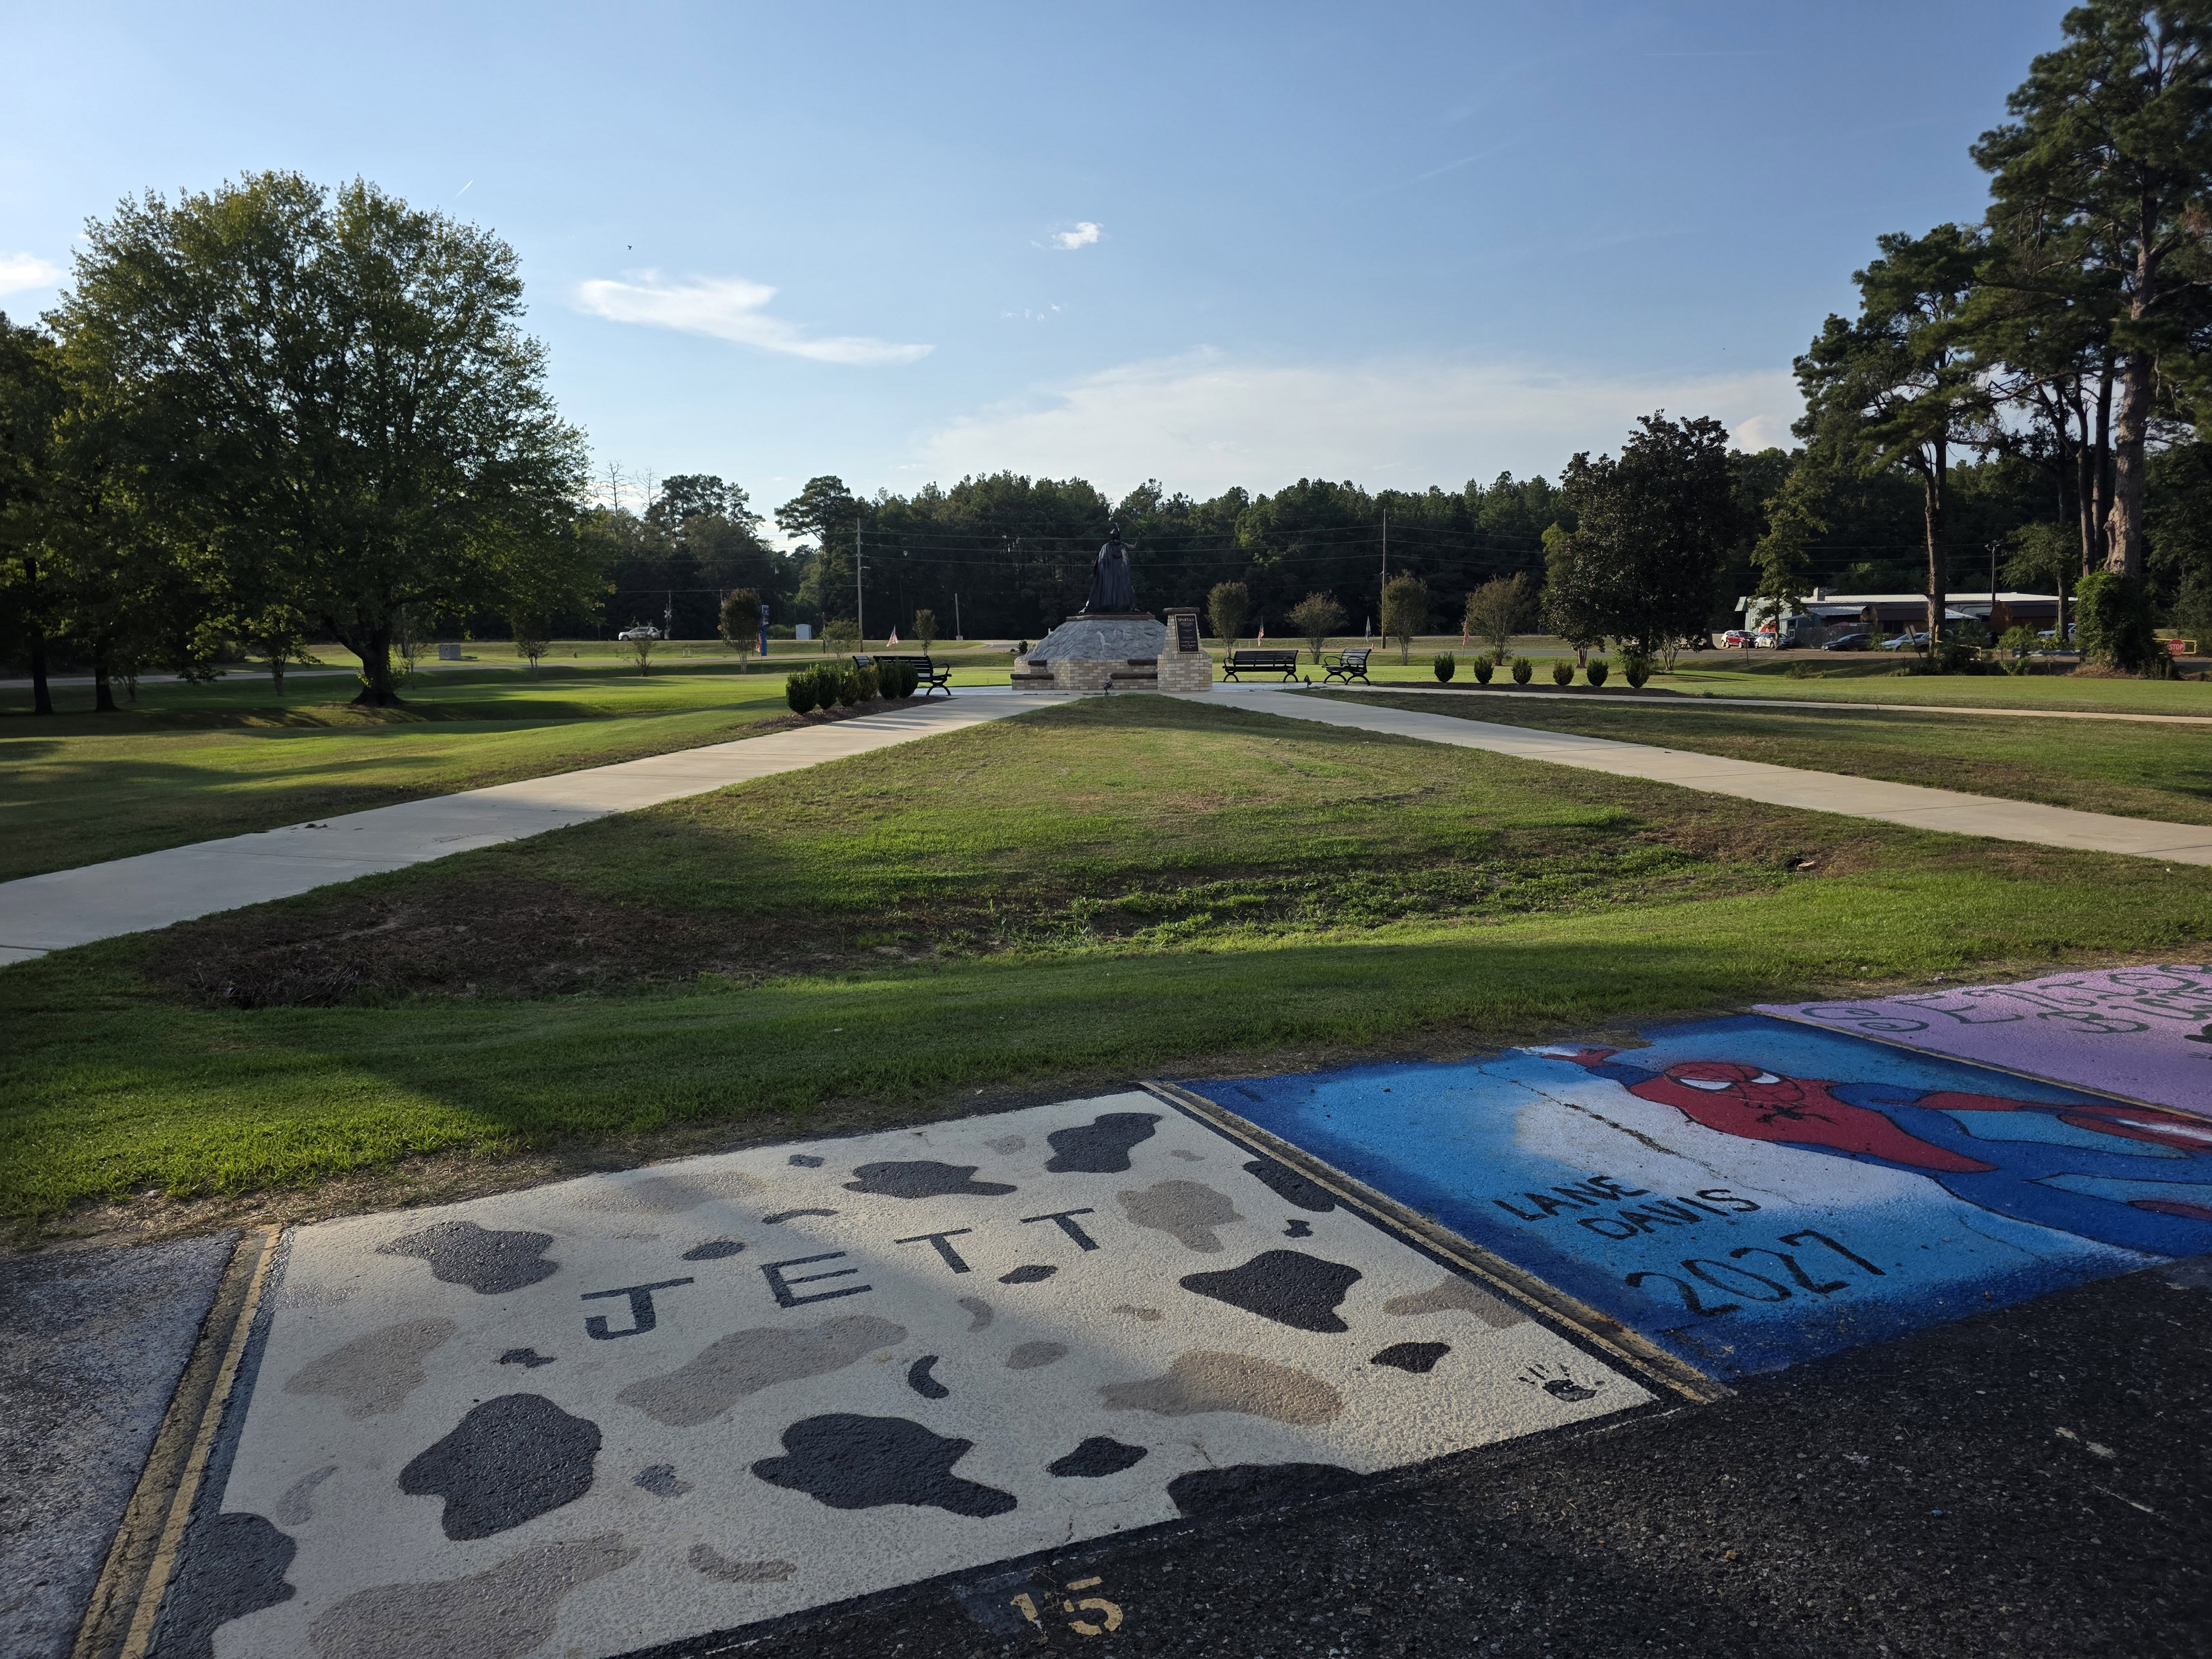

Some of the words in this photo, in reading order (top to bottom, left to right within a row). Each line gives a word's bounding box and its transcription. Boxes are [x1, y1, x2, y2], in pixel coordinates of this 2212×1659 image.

[1493, 1176, 1651, 1220] LANE
[1577, 1189, 1761, 1240] DAVIS
[580, 1207, 1100, 1341] JETT
[1625, 1229, 1886, 1317] 2027
[1010, 1576, 1124, 1636] 15
